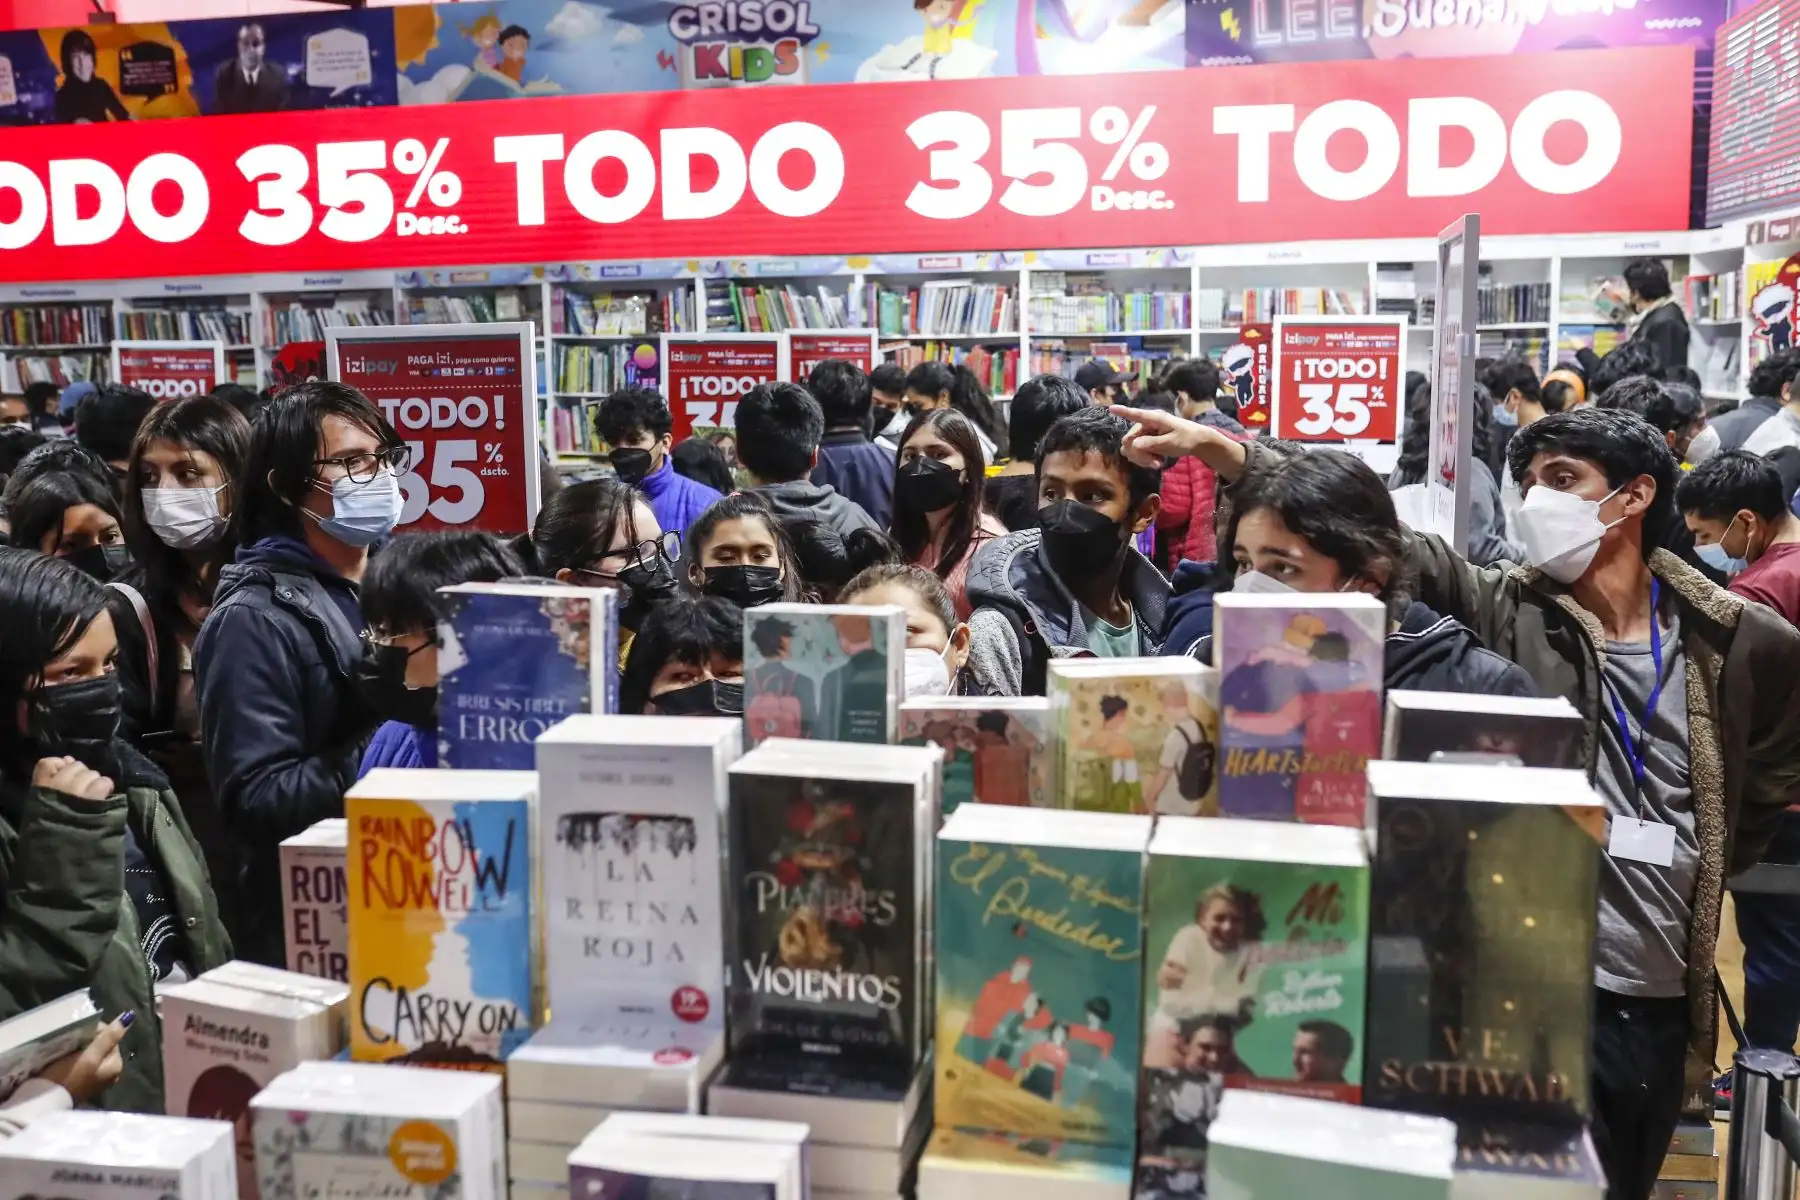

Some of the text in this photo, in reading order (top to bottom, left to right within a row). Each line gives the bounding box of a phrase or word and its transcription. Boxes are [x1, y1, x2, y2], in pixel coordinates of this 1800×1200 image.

[669, 1, 819, 39] CRISOL
[694, 40, 800, 83] KIDS
[0, 152, 210, 250] ODO
[494, 121, 845, 227] TODO
[1213, 90, 1622, 203] TODO
[1091, 186, 1175, 212] Desc.
[397, 211, 469, 237] Desc.
[1285, 332, 1319, 346] izipay
[346, 356, 399, 376] izipay
[407, 355, 434, 365] PAGA
[455, 357, 472, 365] paga
[490, 355, 515, 364] quieras
[671, 351, 703, 364] izipay
[1294, 358, 1388, 381] ¡TODO!
[378, 395, 505, 431] TODO!
[480, 466, 510, 476] dscto.
[459, 714, 562, 743] ERRO
[359, 814, 516, 901] RAINBOW
[606, 859, 655, 883] LA
[360, 839, 505, 913] ROWELL
[565, 897, 699, 926] REINA
[744, 871, 897, 927] PLACERES
[294, 908, 331, 946] EL
[583, 936, 685, 966] ROJA
[743, 950, 903, 1011] VIOLENTOS
[360, 976, 520, 1046] CARRY ON
[183, 1013, 270, 1050] Almendra
[1379, 1059, 1571, 1101] SCHWAB
